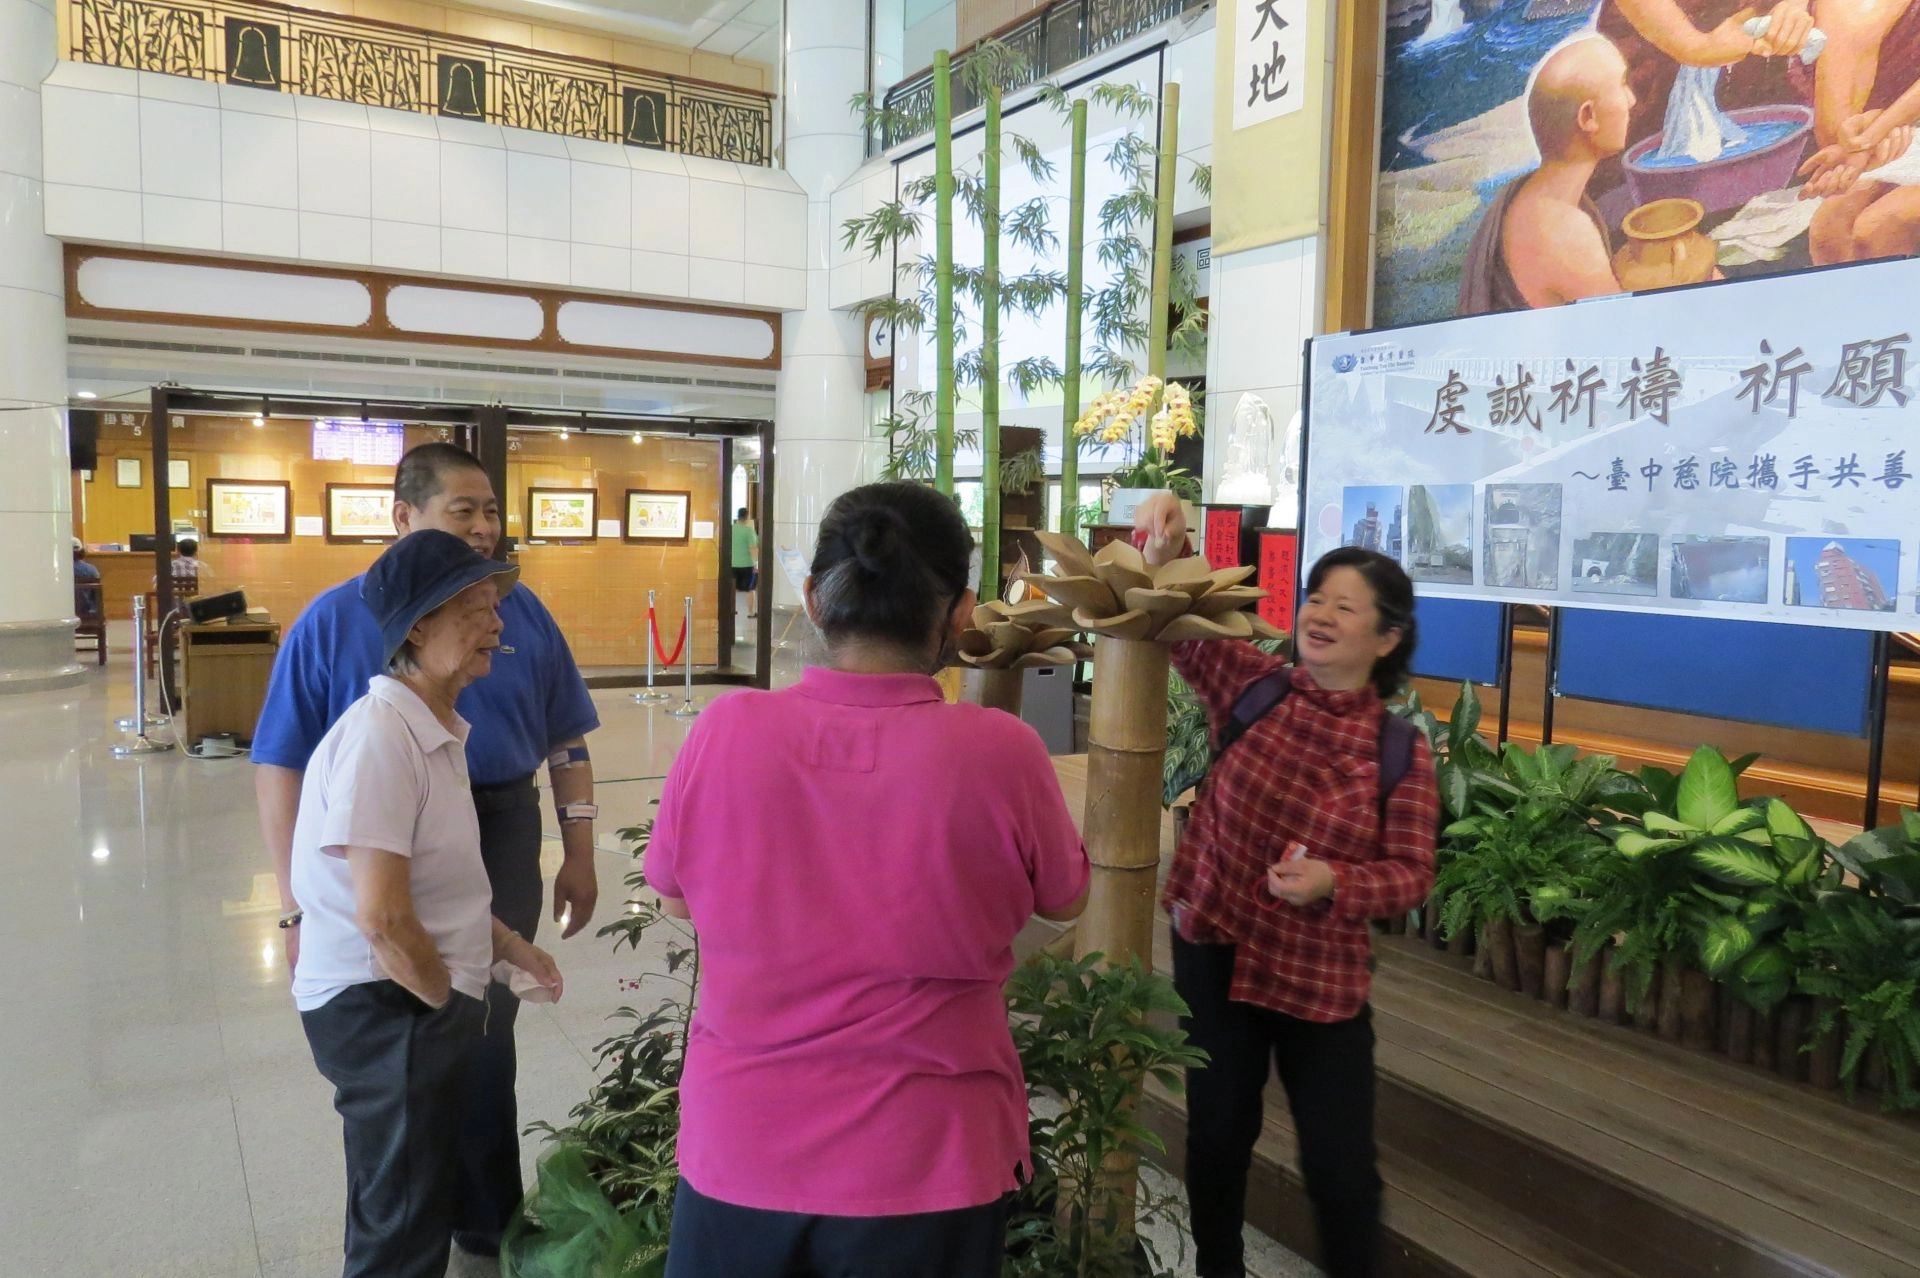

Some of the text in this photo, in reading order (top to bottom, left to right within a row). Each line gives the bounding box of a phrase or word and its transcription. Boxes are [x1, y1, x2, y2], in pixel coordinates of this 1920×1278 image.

[1424, 333, 1912, 435] 虔誠祈禱 祈願
